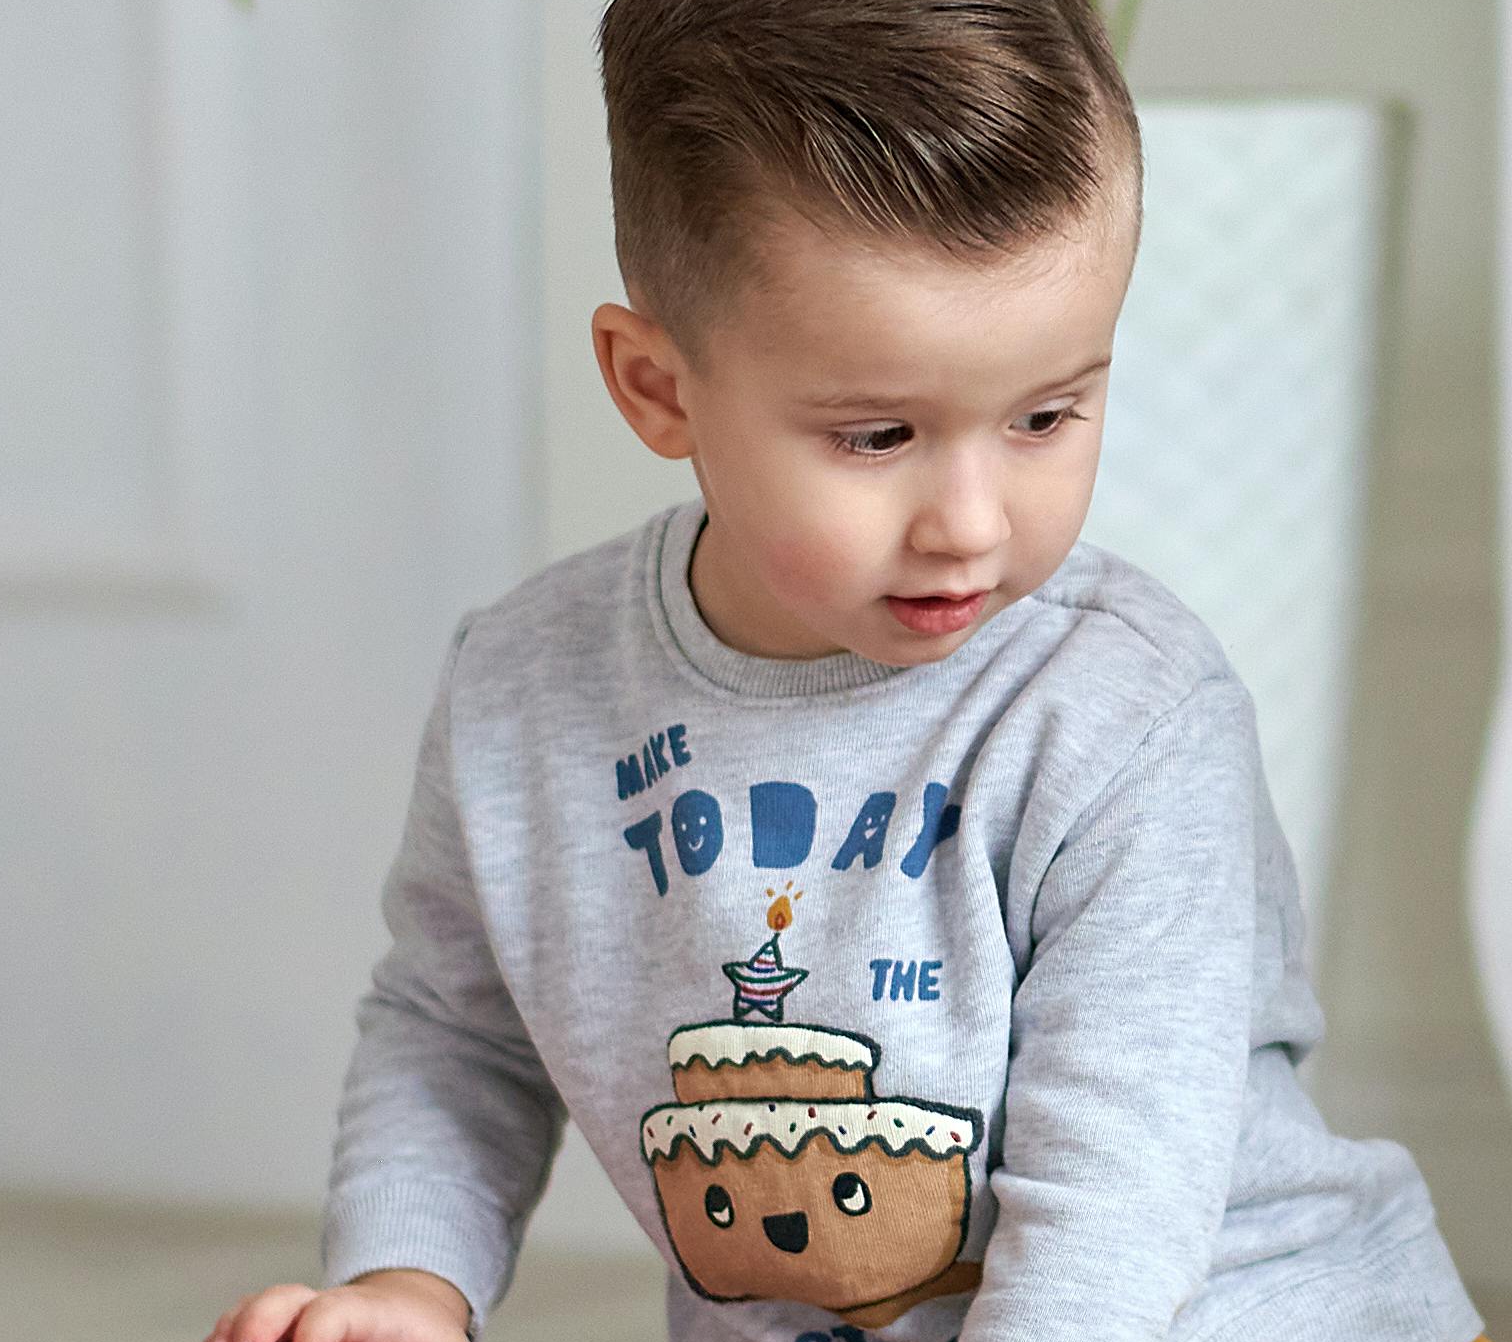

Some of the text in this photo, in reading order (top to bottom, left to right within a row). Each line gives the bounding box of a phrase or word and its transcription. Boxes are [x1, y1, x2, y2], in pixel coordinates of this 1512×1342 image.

[615, 723, 691, 801] MAKE
[623, 781, 962, 898] TODAY
[869, 958, 942, 1002] THE
